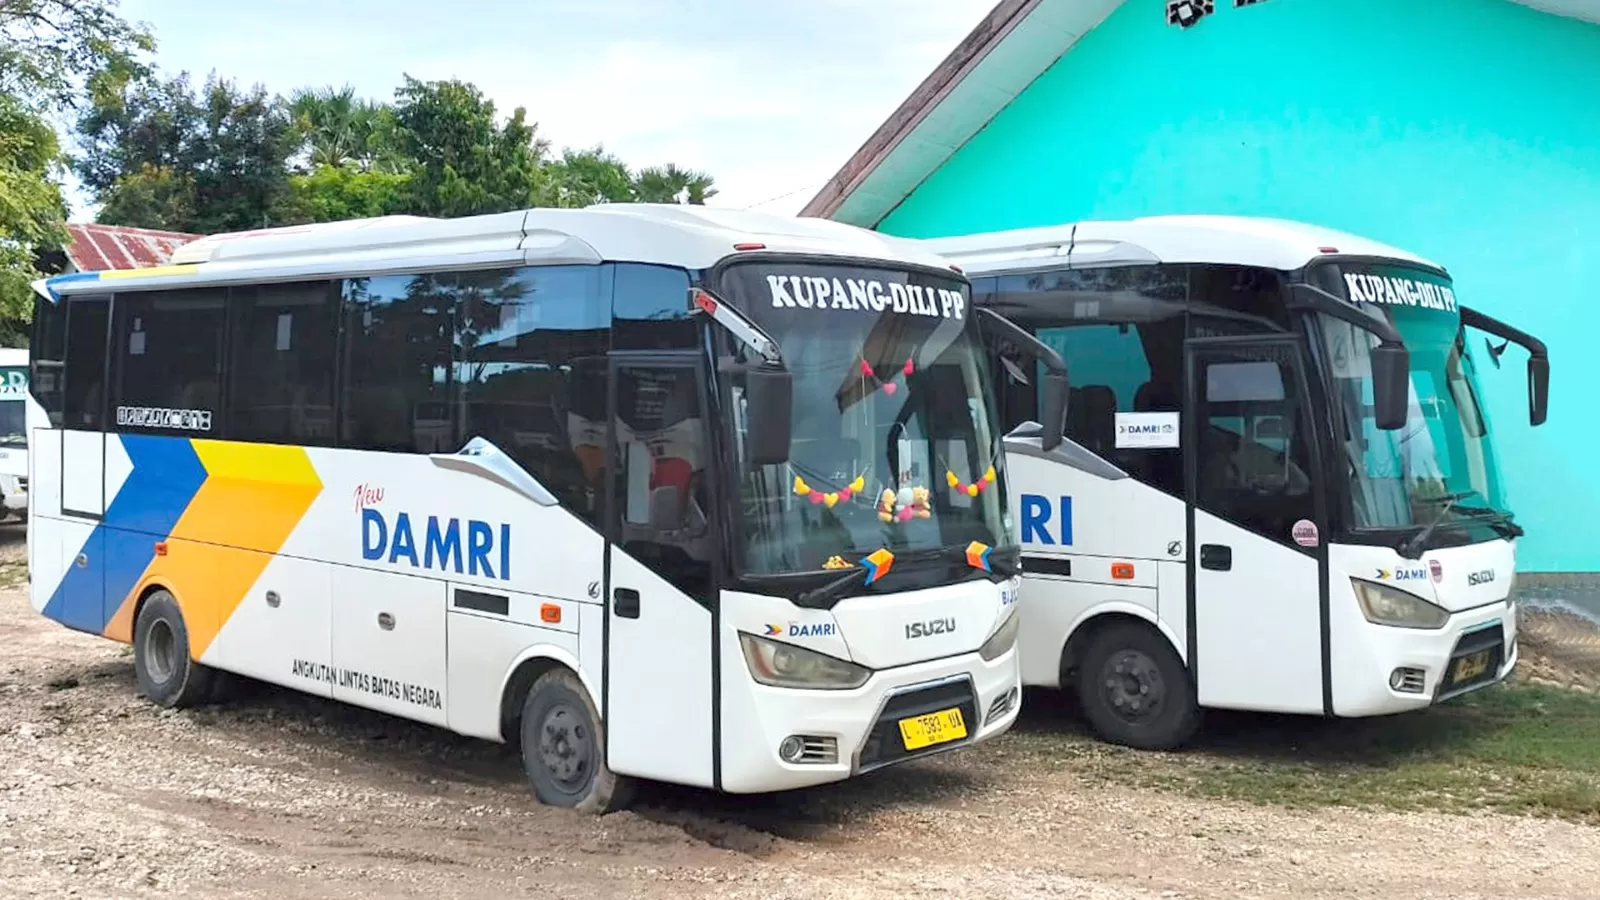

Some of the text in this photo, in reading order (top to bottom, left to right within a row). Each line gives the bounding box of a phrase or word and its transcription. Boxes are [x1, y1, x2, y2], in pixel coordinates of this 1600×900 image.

[766, 274, 965, 320] KUPANG-DILI PP
[1343, 273, 1457, 312] KUPANG-DILI PP
[1128, 424, 1161, 434] DAMRI
[354, 483, 385, 513] New
[362, 507, 511, 581] DAMRI
[1395, 569, 1427, 580] DAMRI
[789, 623, 836, 637] DAMRI
[905, 617, 956, 639] ISUZU
[292, 658, 442, 710] ANGKUTAN LINTAS BATAS NEGARA
